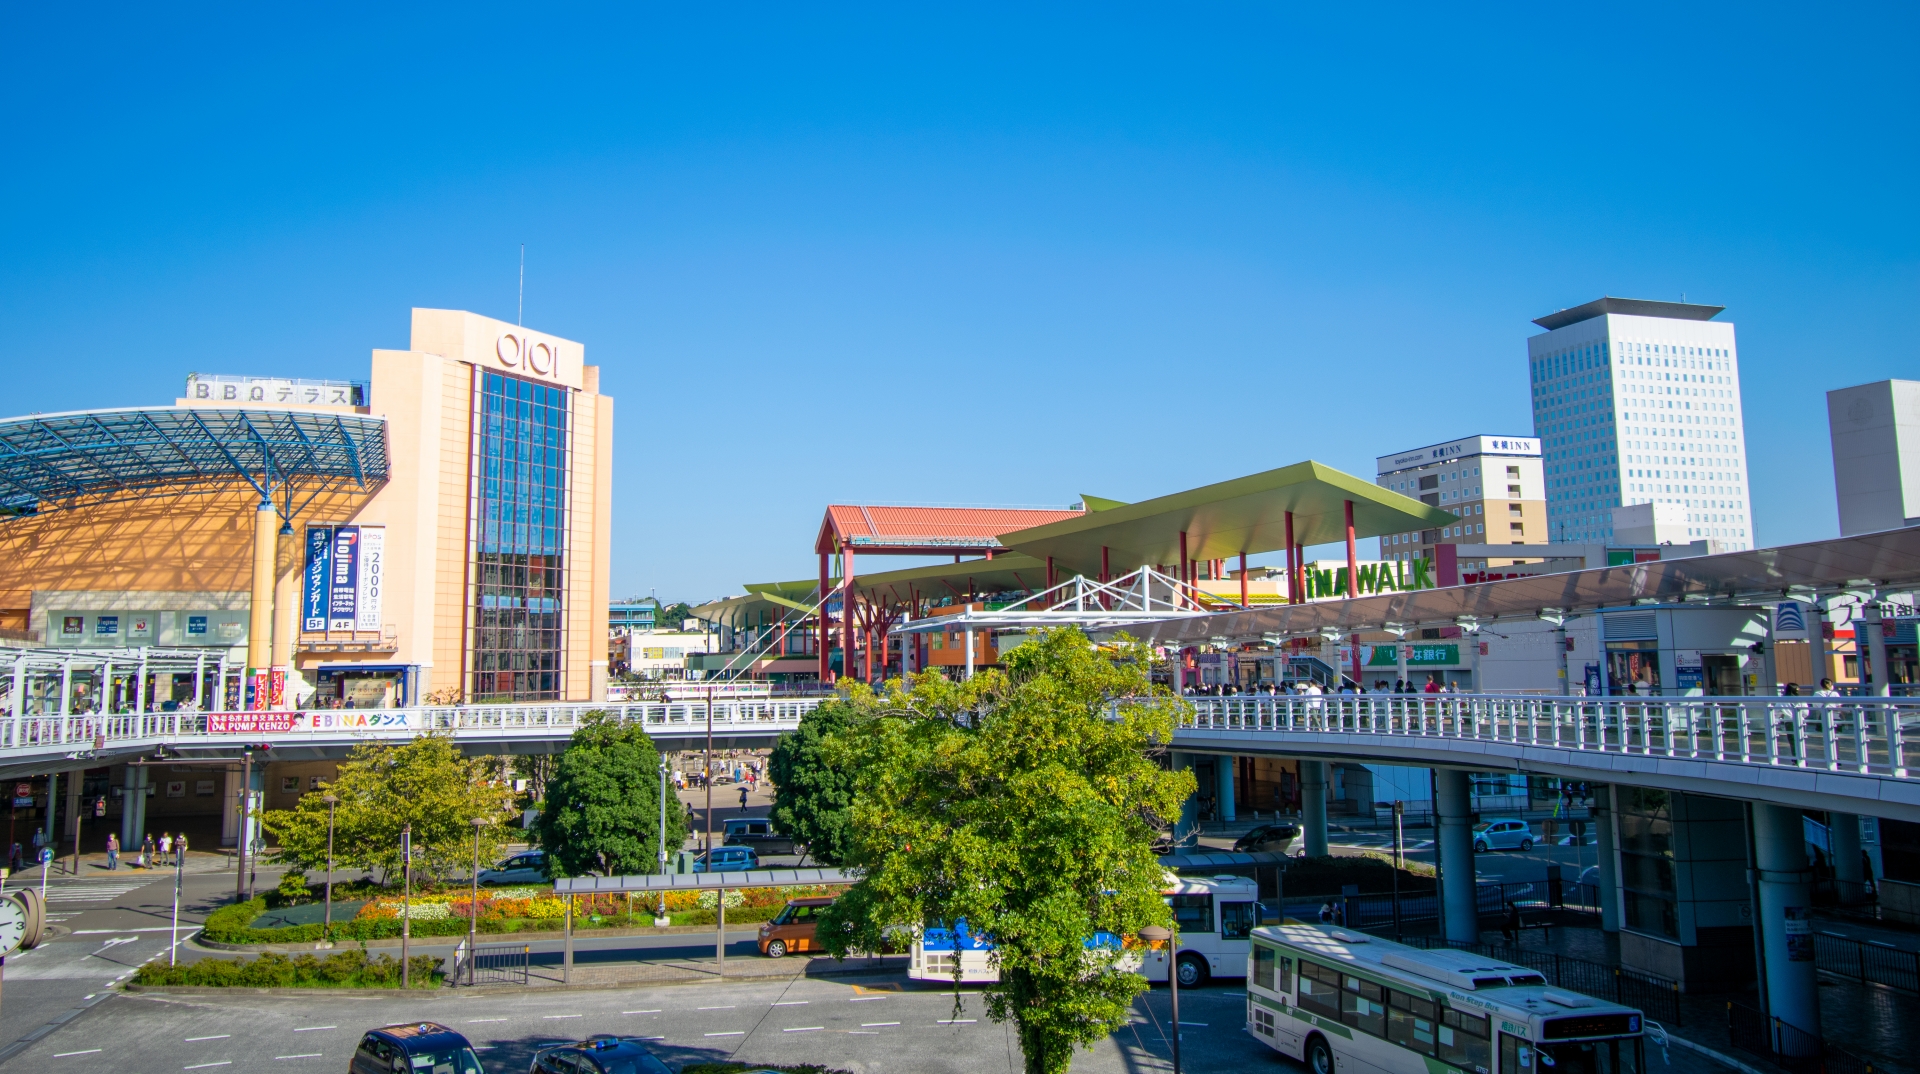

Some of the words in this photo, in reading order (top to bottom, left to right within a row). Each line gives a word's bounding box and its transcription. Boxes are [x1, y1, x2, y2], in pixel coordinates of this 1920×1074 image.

[309, 619, 323, 628] 5F
[272, 672, 280, 704] レストラン
[212, 722, 226, 731] DA
[228, 722, 257, 731] PUMP
[258, 722, 290, 730] KENZO
[16, 921, 25, 931] 3
[1450, 991, 1465, 1001] Non
[1466, 996, 1484, 1008] Step
[1484, 1002, 1500, 1012] Bus
